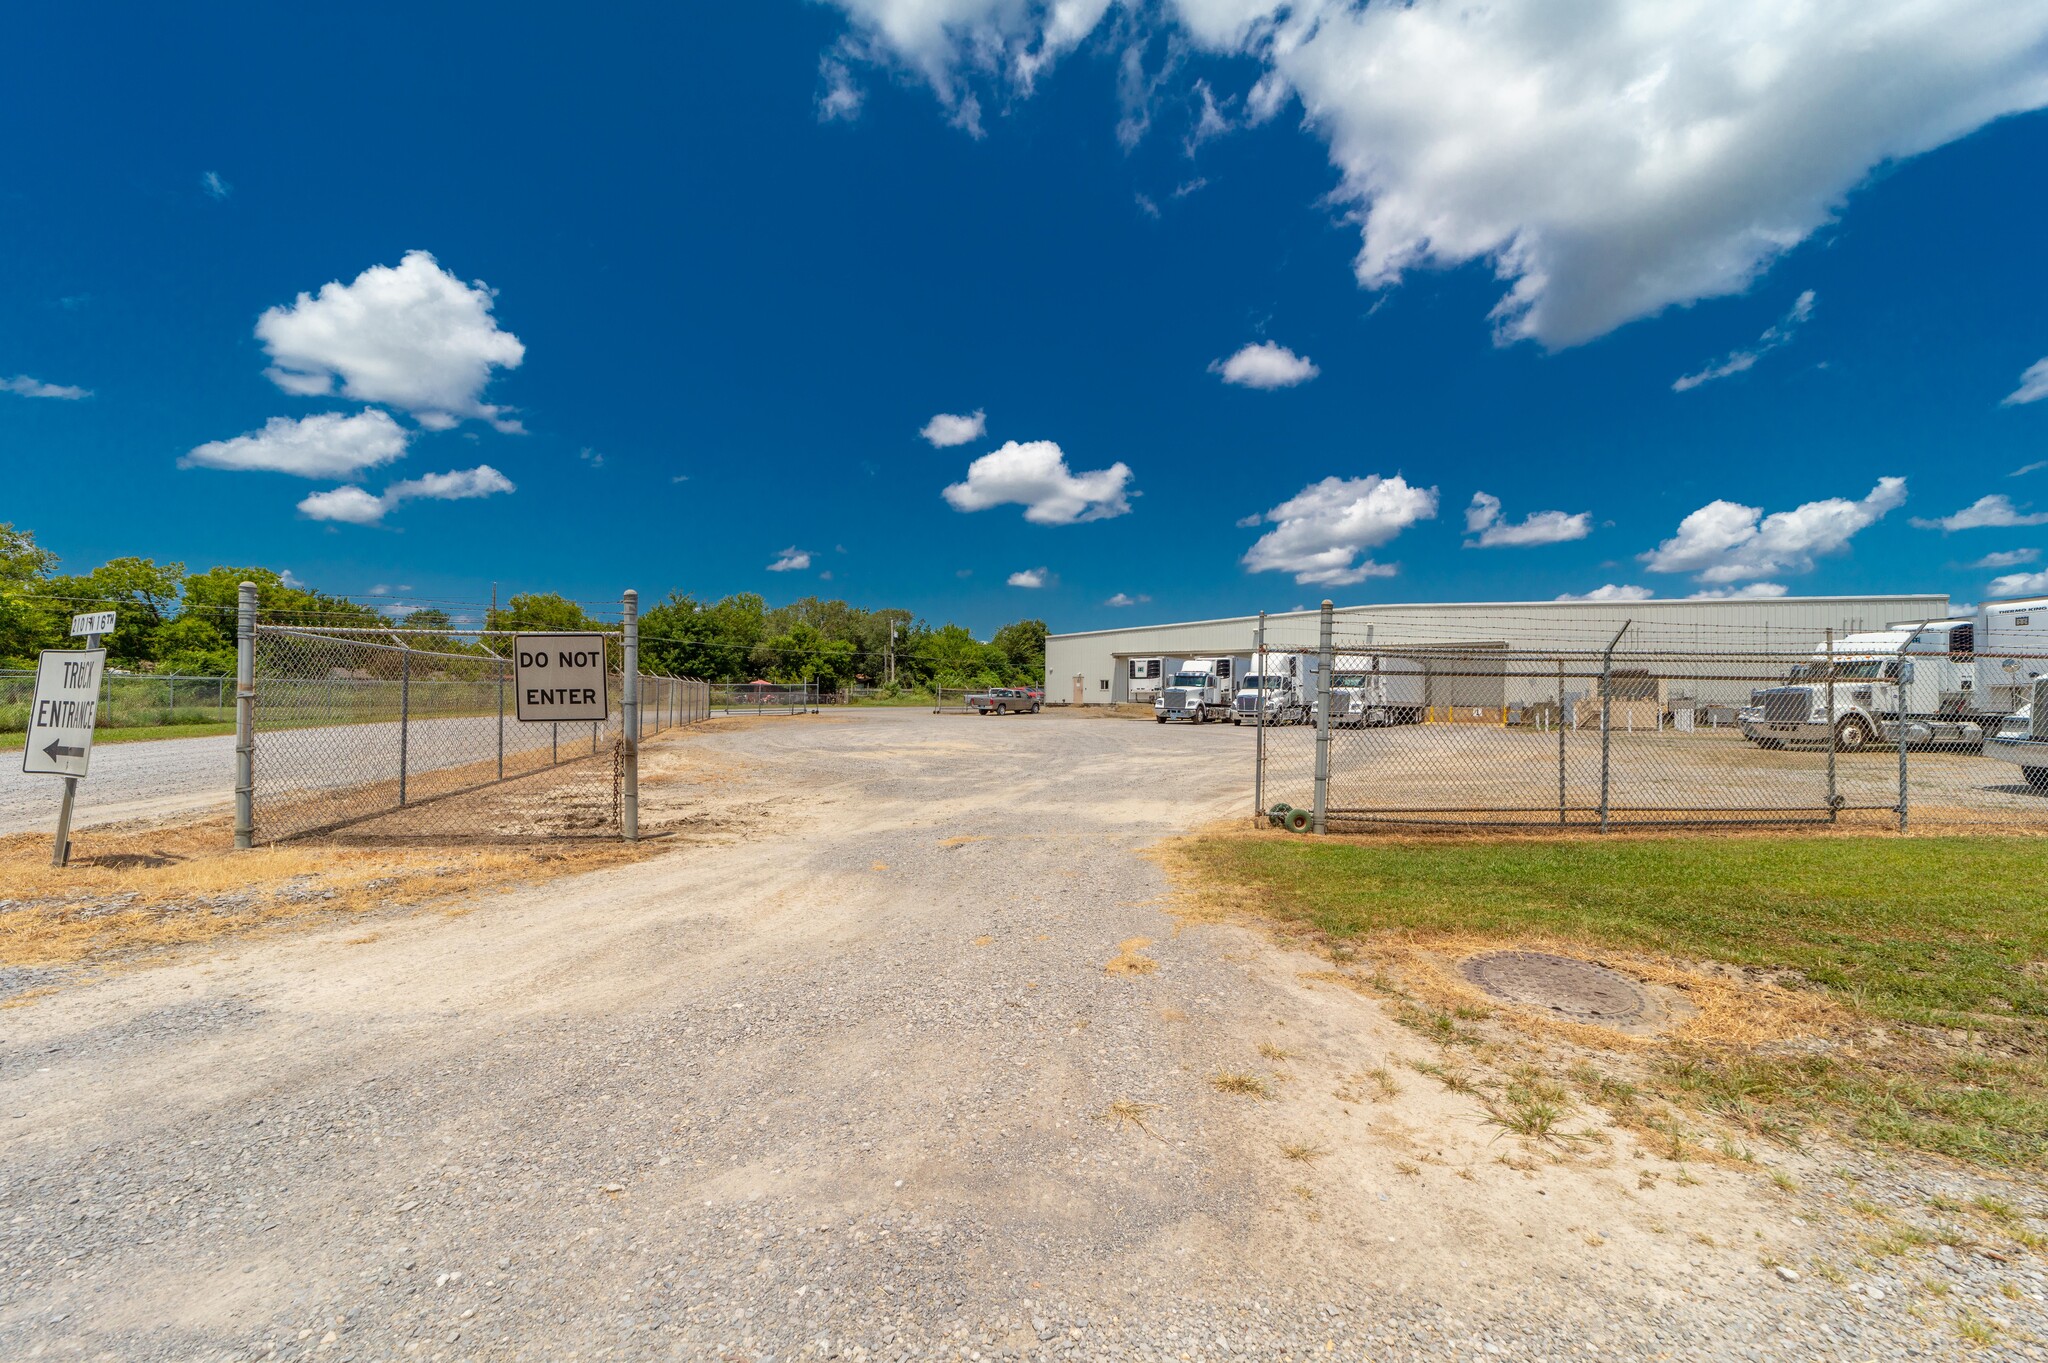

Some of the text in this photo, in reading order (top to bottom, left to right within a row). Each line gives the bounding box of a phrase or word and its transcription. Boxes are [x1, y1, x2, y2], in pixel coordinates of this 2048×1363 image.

[520, 651, 600, 668] DO NOT
[63, 661, 94, 688] TRUCK
[527, 688, 597, 705] ENTER
[37, 700, 95, 729] ENTRANCE
